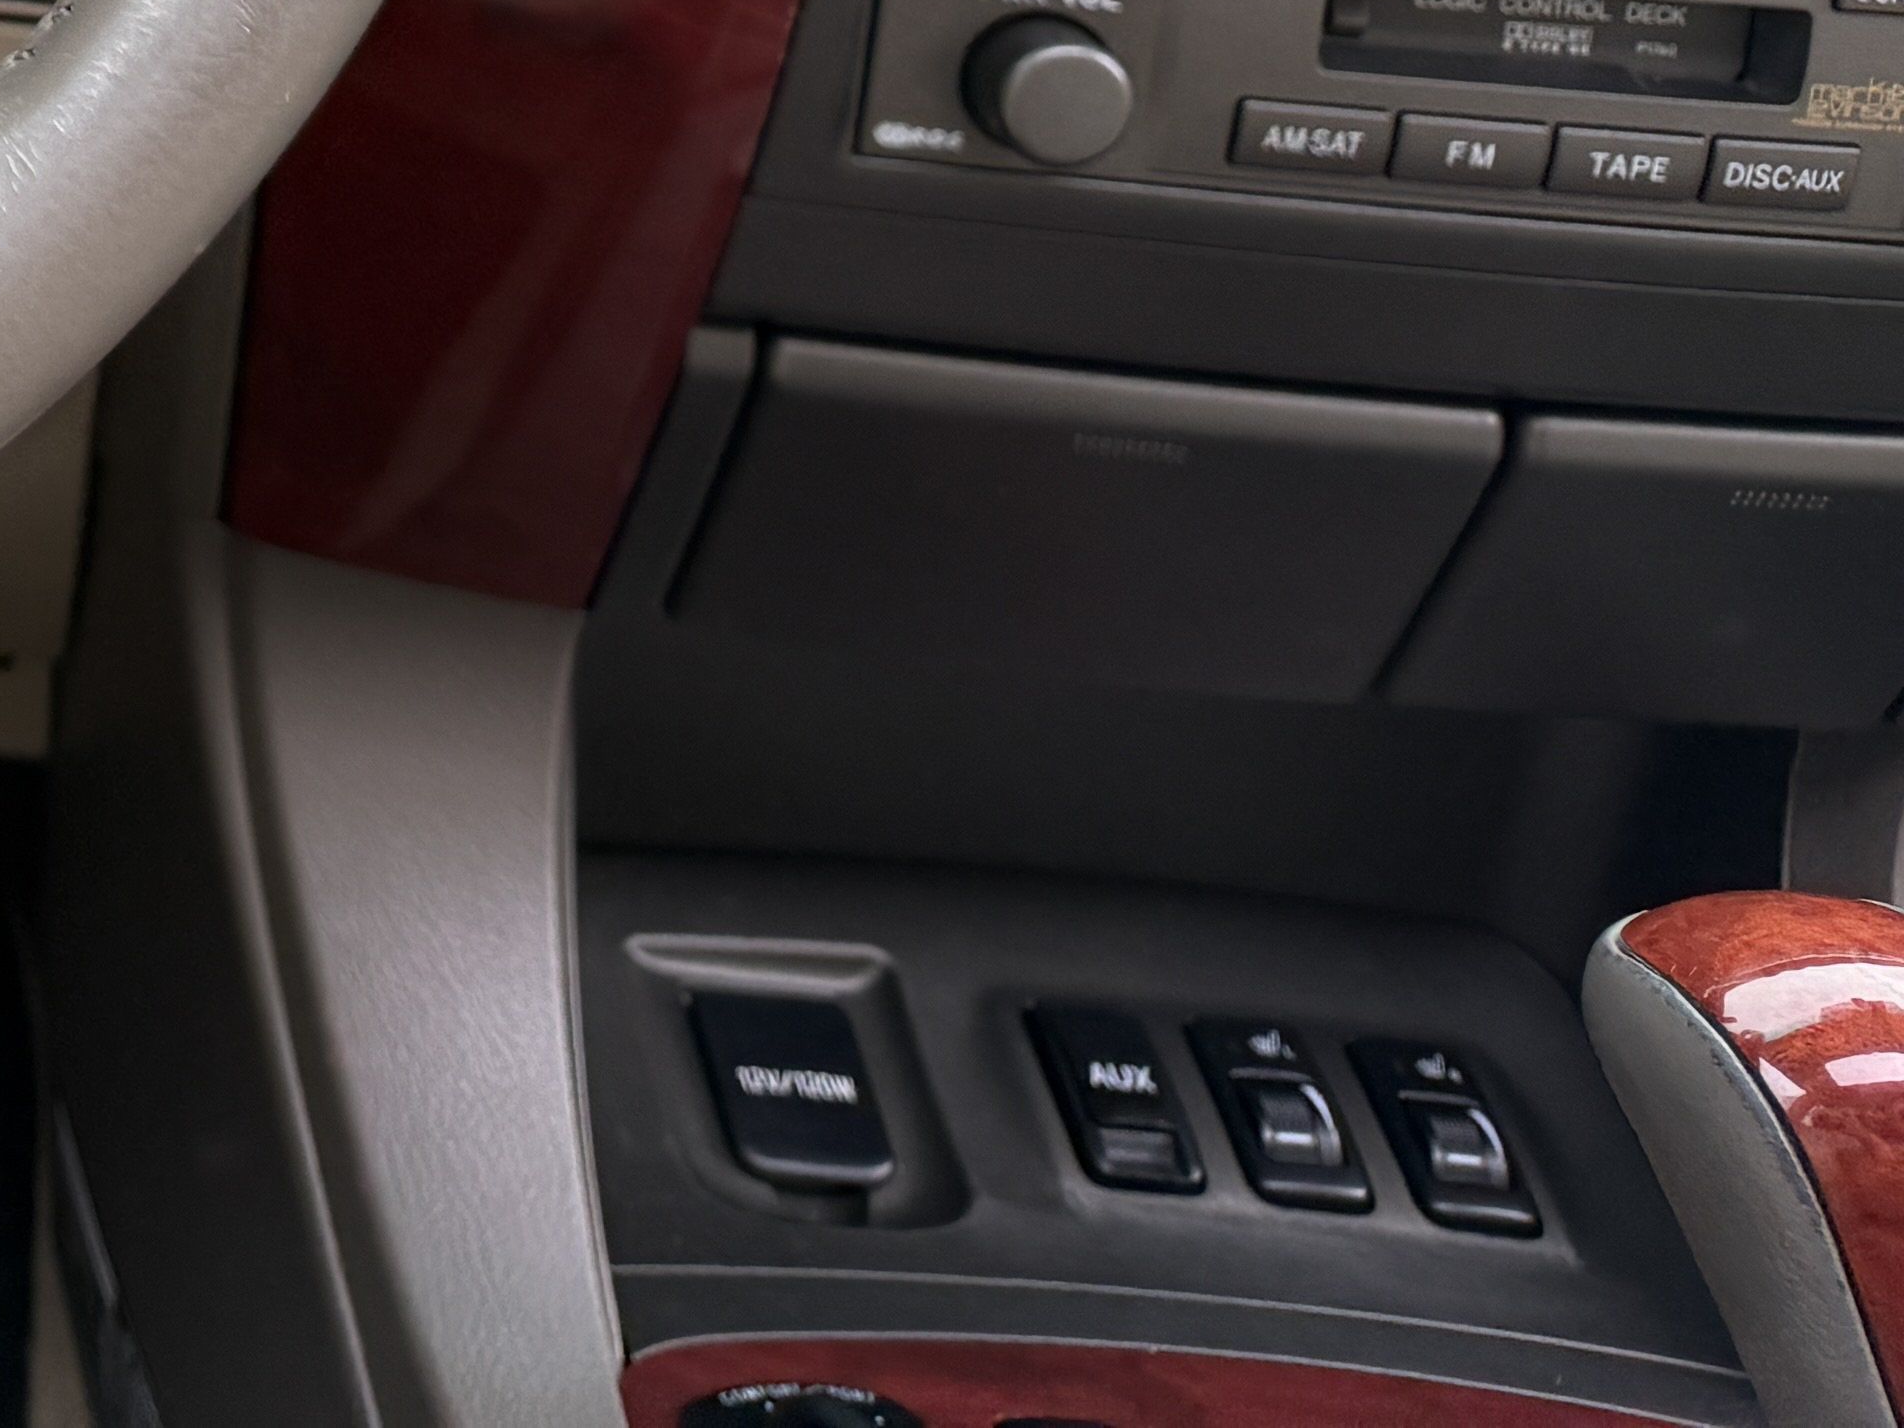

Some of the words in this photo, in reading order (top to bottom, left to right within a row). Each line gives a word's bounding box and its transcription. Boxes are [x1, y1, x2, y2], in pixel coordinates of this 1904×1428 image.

[1624, 1, 1688, 27] DECK
[1445, 141, 1496, 170] FM
[1589, 151, 1671, 183] TAPE
[1089, 1061, 1159, 1095] AUX
